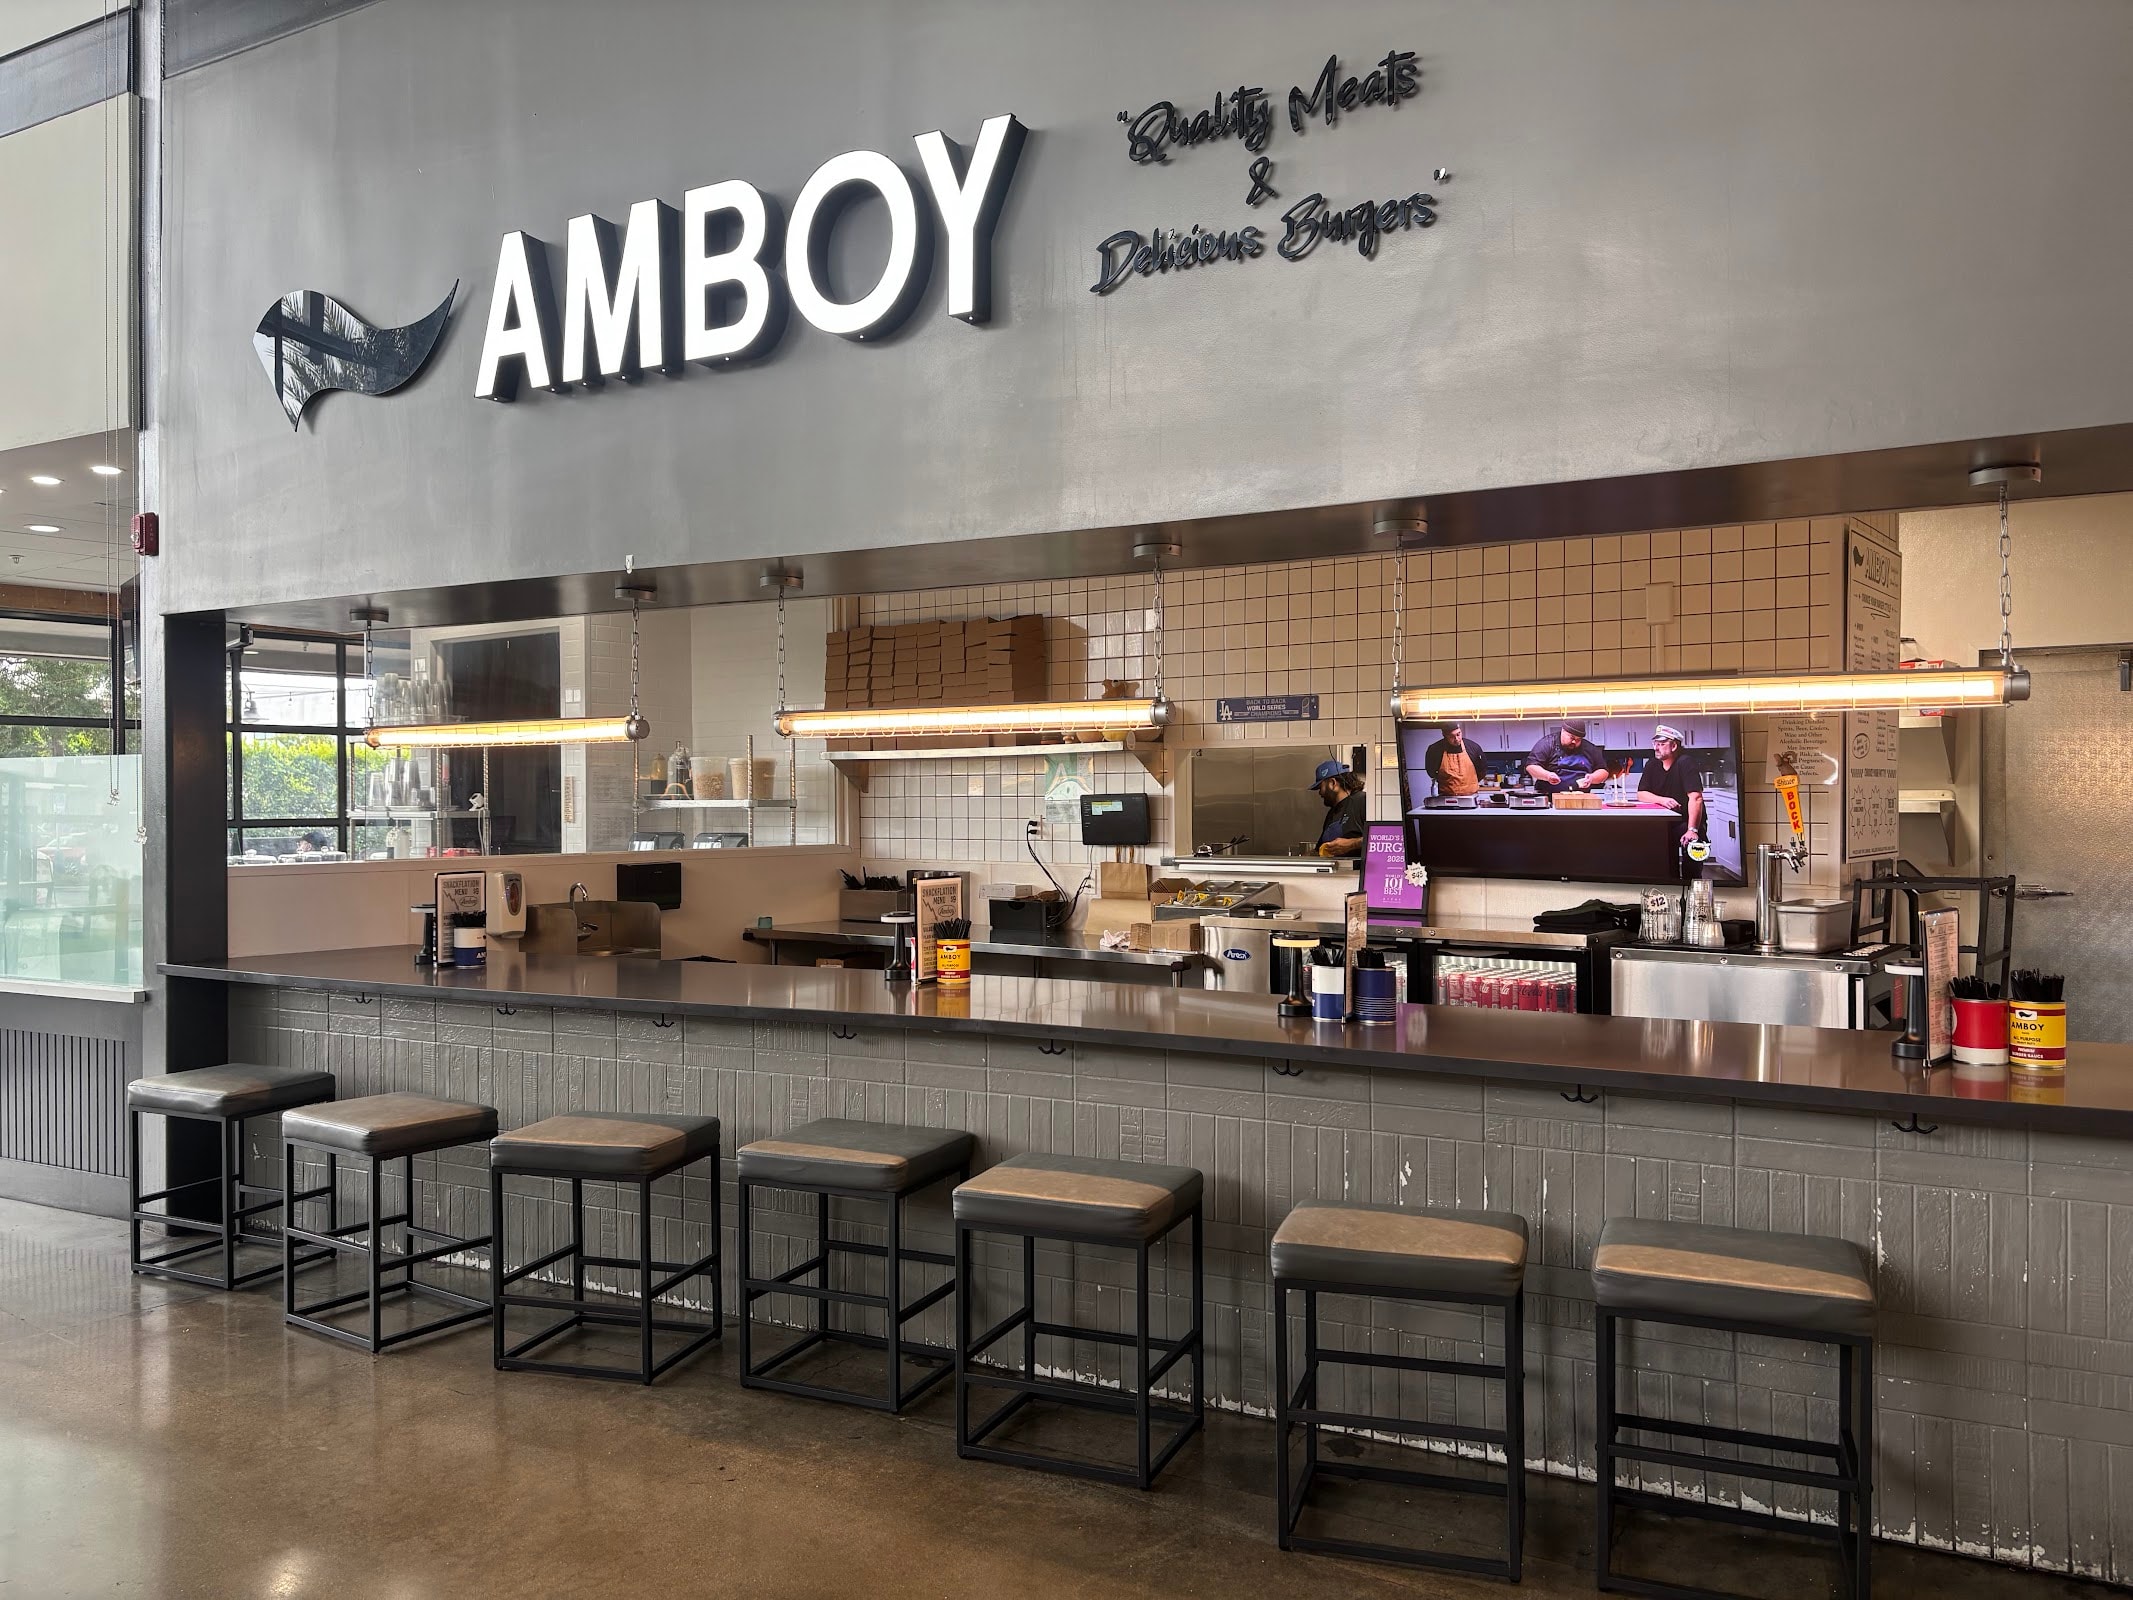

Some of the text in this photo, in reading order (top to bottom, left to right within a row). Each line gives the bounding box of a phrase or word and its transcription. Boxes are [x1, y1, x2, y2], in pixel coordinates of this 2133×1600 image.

[1288, 49, 1419, 132] Meats
[1245, 156, 1276, 206] &
[474, 112, 1022, 400] AMBOY
[1089, 224, 1262, 294] Delicious
[1786, 791, 1801, 830] BOCK
[1369, 842, 1405, 853] BURG
[1386, 855, 1405, 863] 2025
[1384, 877, 1403, 889] 101
[922, 886, 957, 898] SNACKFLATION
[1384, 888, 1403, 896] BEST
[933, 896, 946, 904] MENU
[1650, 896, 1666, 907] $12
[2011, 1021, 2045, 1031] AMBOY
